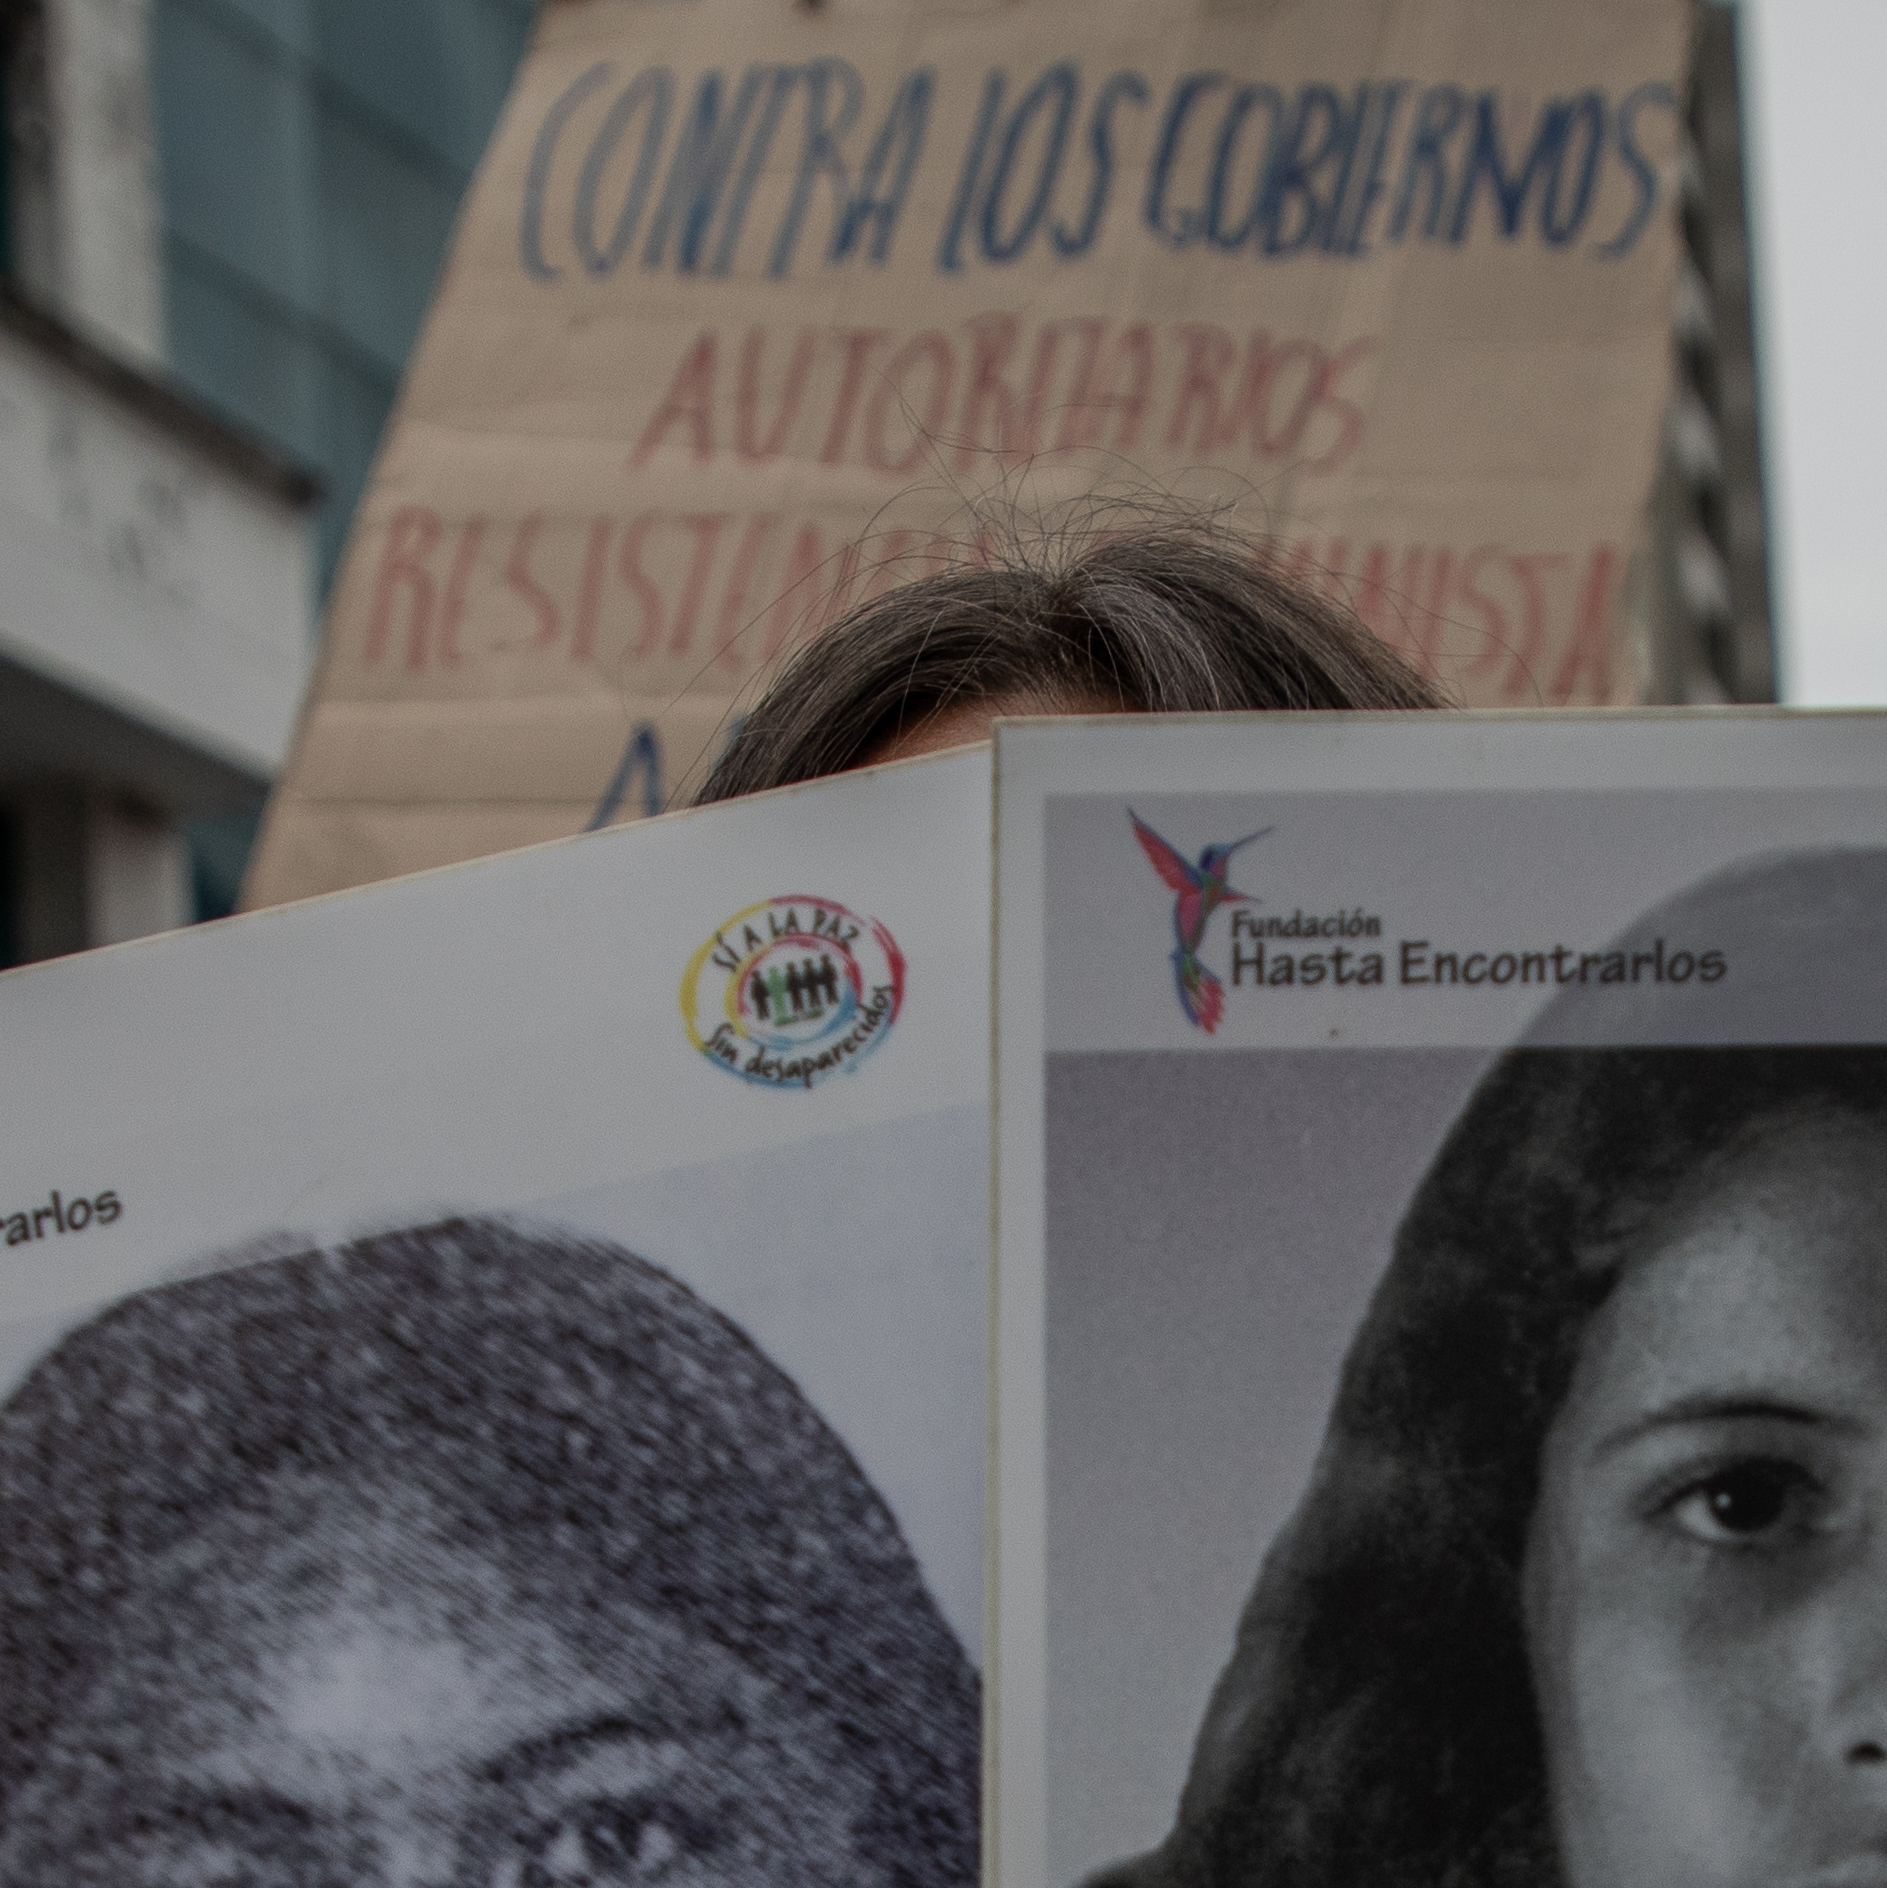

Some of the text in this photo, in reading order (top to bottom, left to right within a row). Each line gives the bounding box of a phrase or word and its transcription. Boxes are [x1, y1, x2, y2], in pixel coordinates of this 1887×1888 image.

[516, 55, 934, 284] CONTRA
[1145, 72, 1687, 261] GOBIERNOS
[626, 311, 1380, 479] AUTORITARIOS
[743, 924, 763, 952] A
[768, 907, 800, 937] LA
[813, 907, 860, 948] PAZ
[1230, 908, 1382, 940] Fundación
[1230, 938, 1728, 987] Hasta Encontrarlos
[704, 984, 900, 1088] Sin desaparecidos
